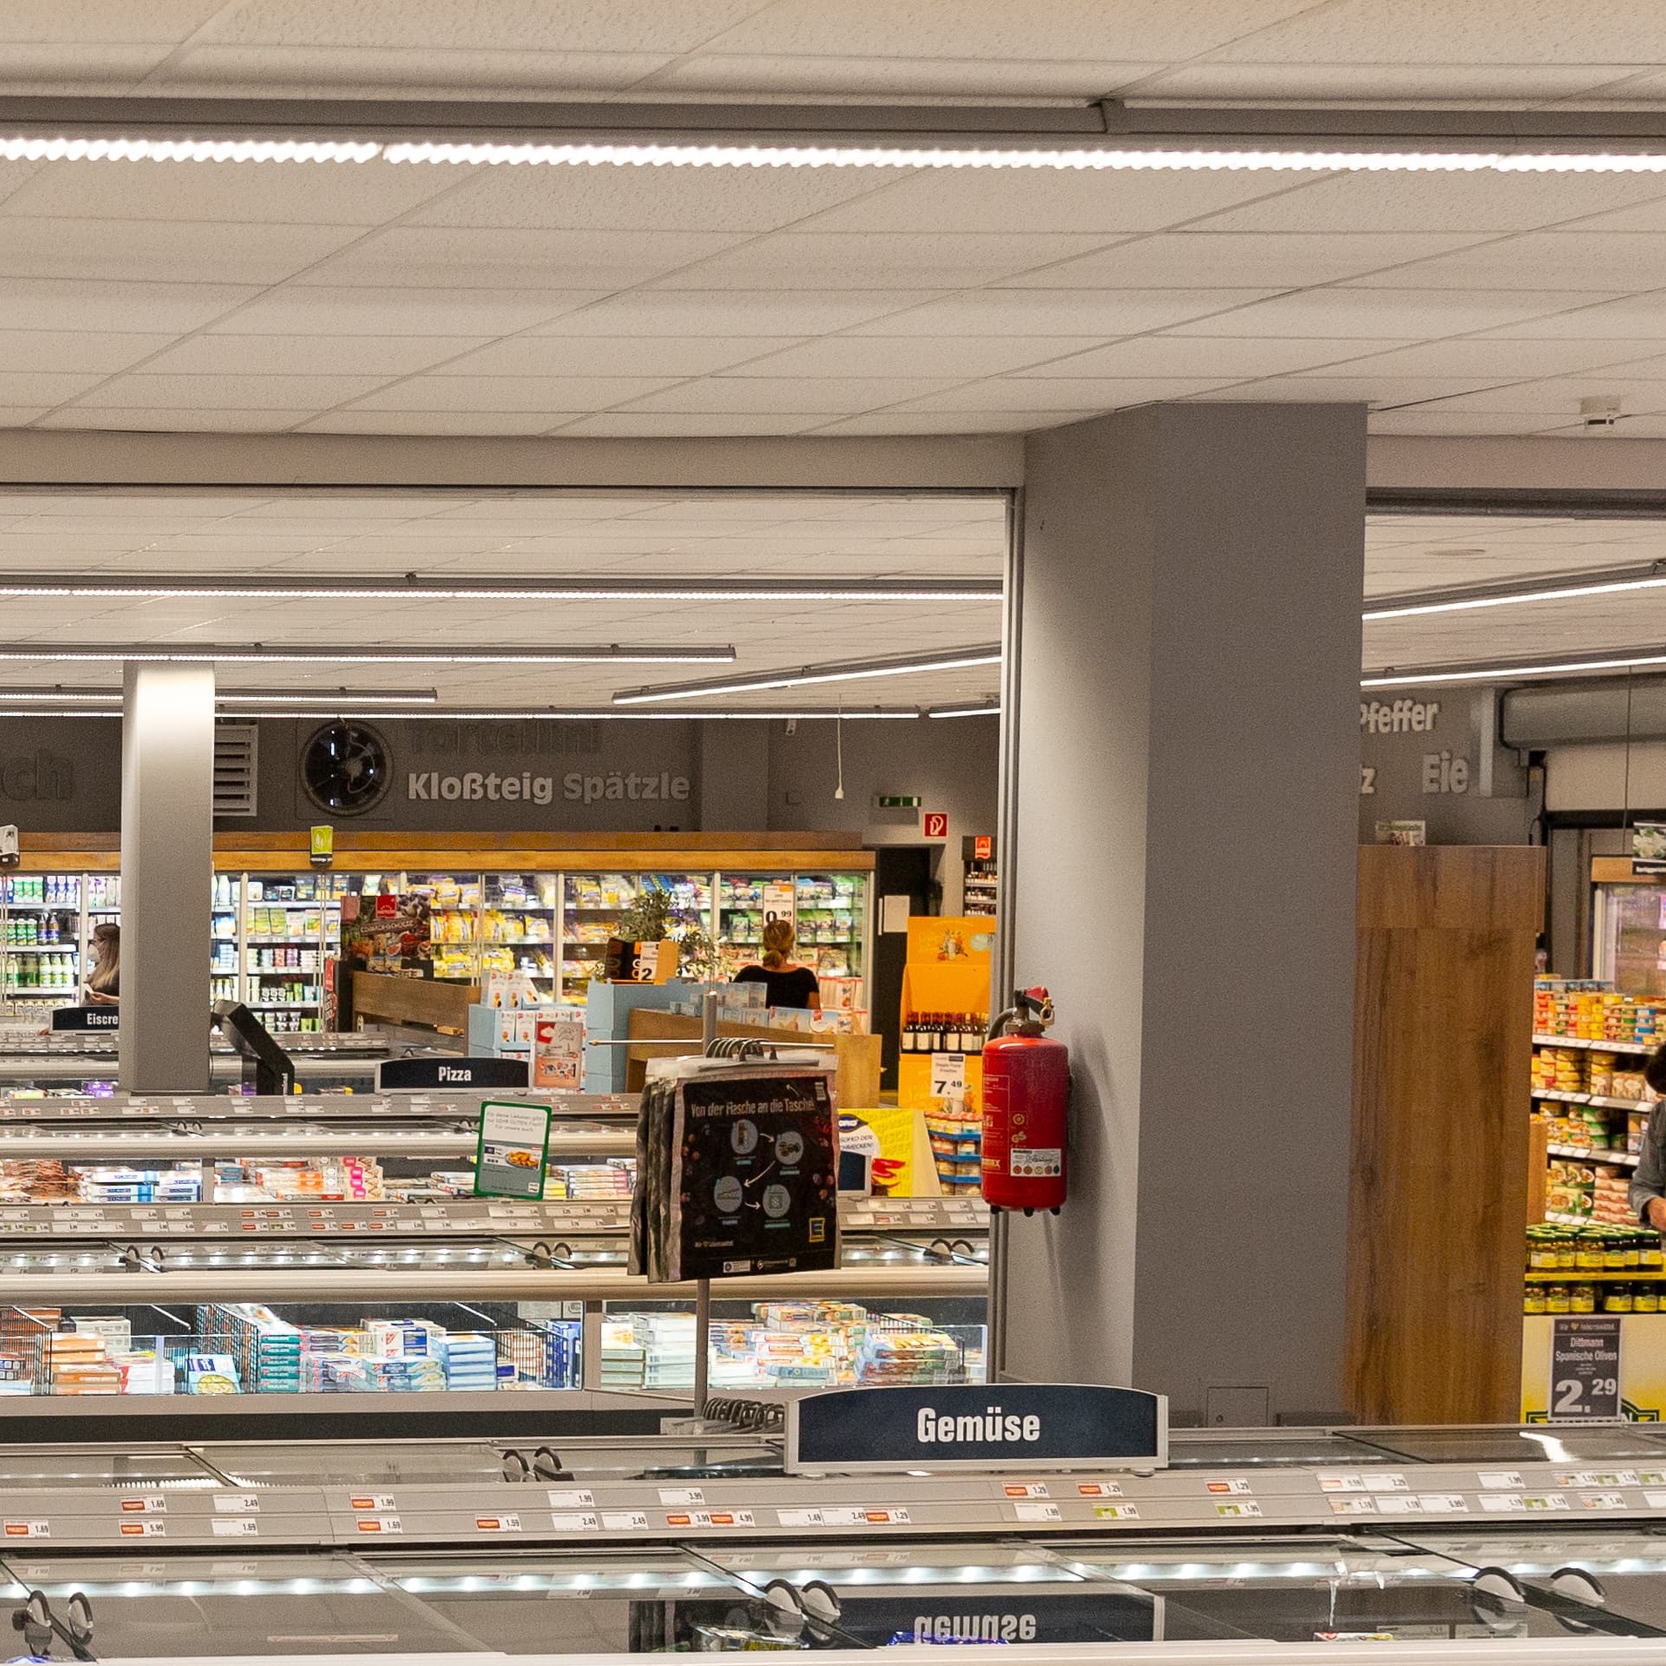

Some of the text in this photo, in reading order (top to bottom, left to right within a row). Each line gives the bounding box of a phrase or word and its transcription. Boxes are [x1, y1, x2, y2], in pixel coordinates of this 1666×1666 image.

[407, 770, 690, 805] Kloßteig Spätzle
[438, 1066, 472, 1082] Pizza
[934, 1080, 963, 1096] 7.49
[691, 1102, 706, 1118] Von
[707, 1102, 724, 1116] der
[757, 1101, 769, 1113] an
[770, 1100, 783, 1113] die
[1555, 1350, 1593, 1363] Spanische
[1554, 1378, 1617, 1414] 2.29
[916, 1405, 1041, 1445] Gemüse
